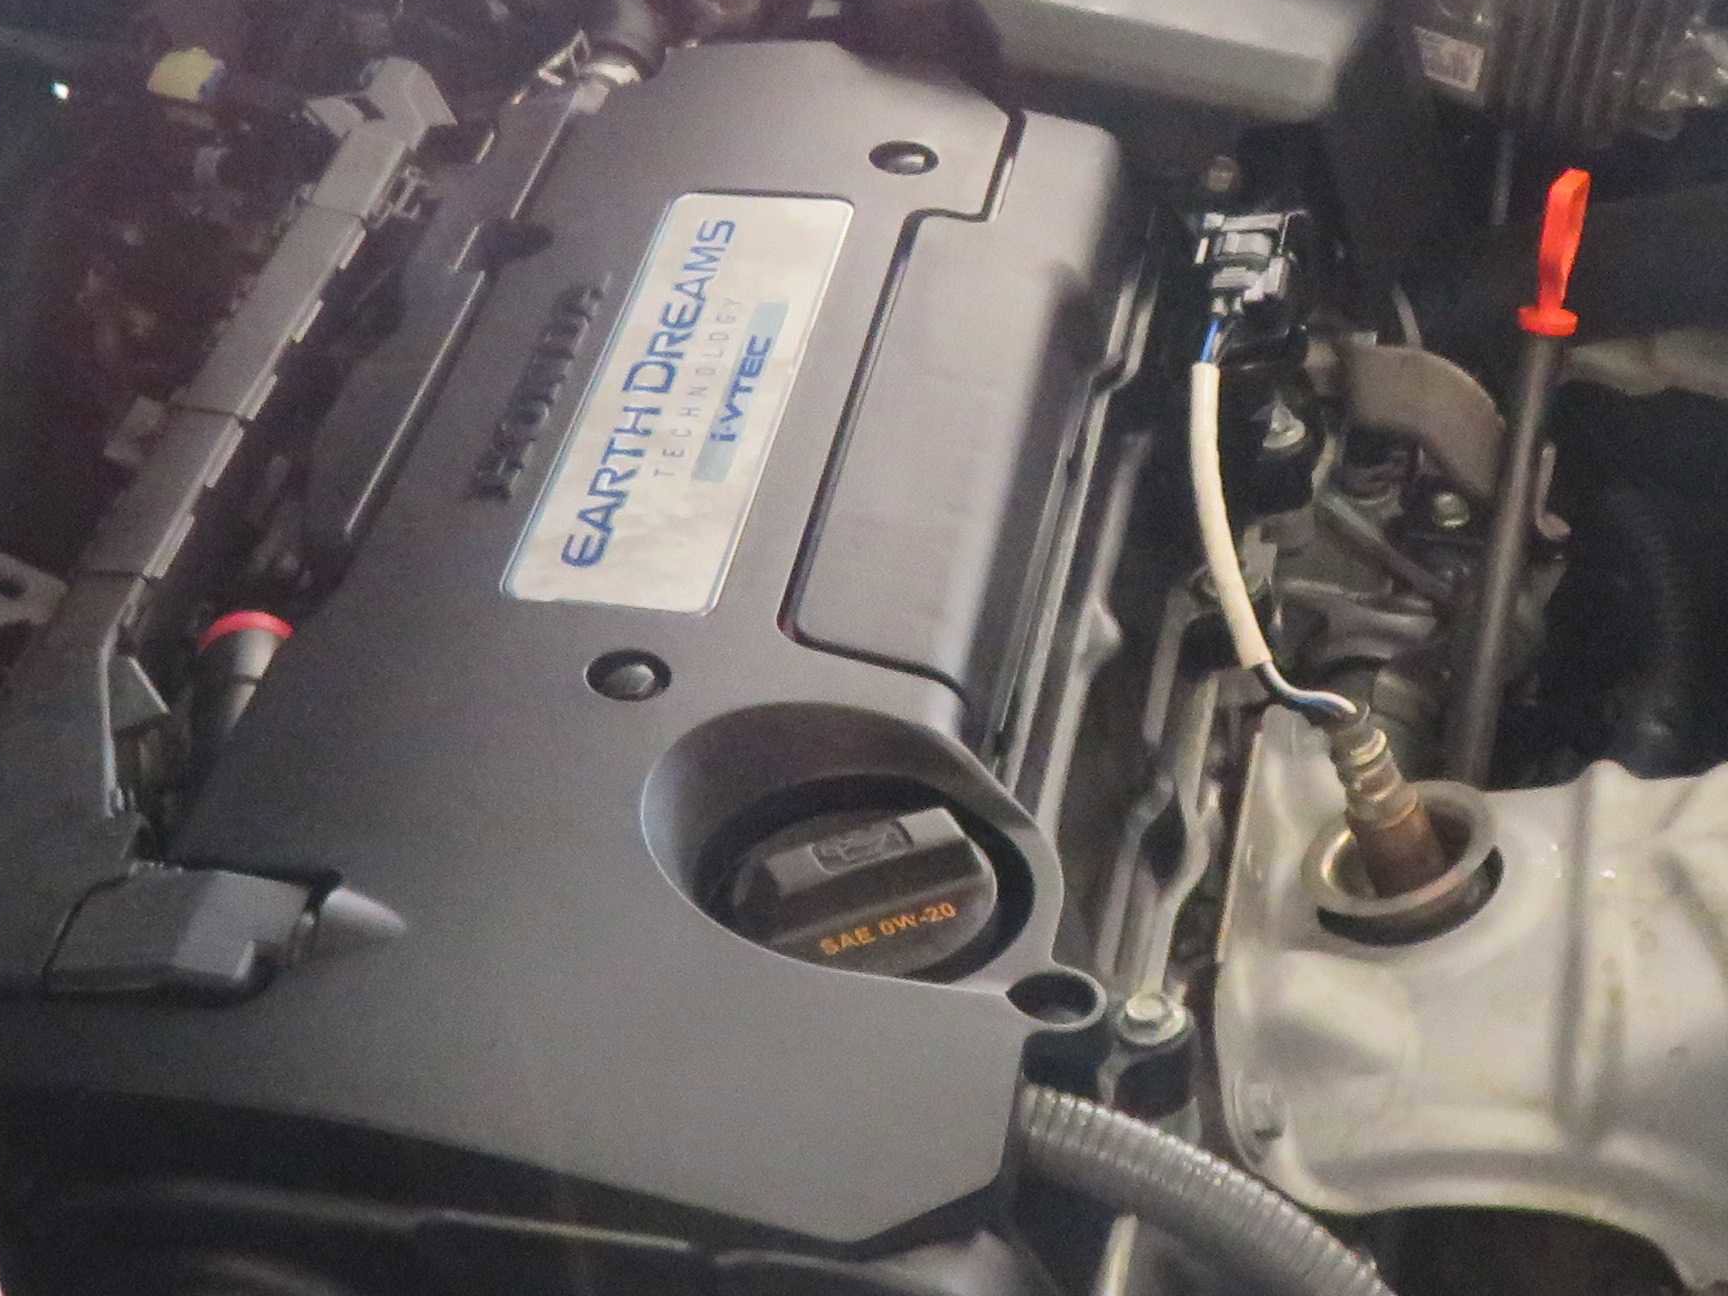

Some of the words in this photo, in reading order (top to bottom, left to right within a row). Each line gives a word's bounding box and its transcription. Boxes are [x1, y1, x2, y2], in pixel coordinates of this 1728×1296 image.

[561, 403, 662, 569] EARTH
[623, 217, 737, 394] DREAMS
[652, 296, 743, 480] TECHNOLOGY
[710, 333, 773, 444] i-VTEC
[818, 926, 877, 956] SAE
[878, 901, 960, 936] 0W-20
